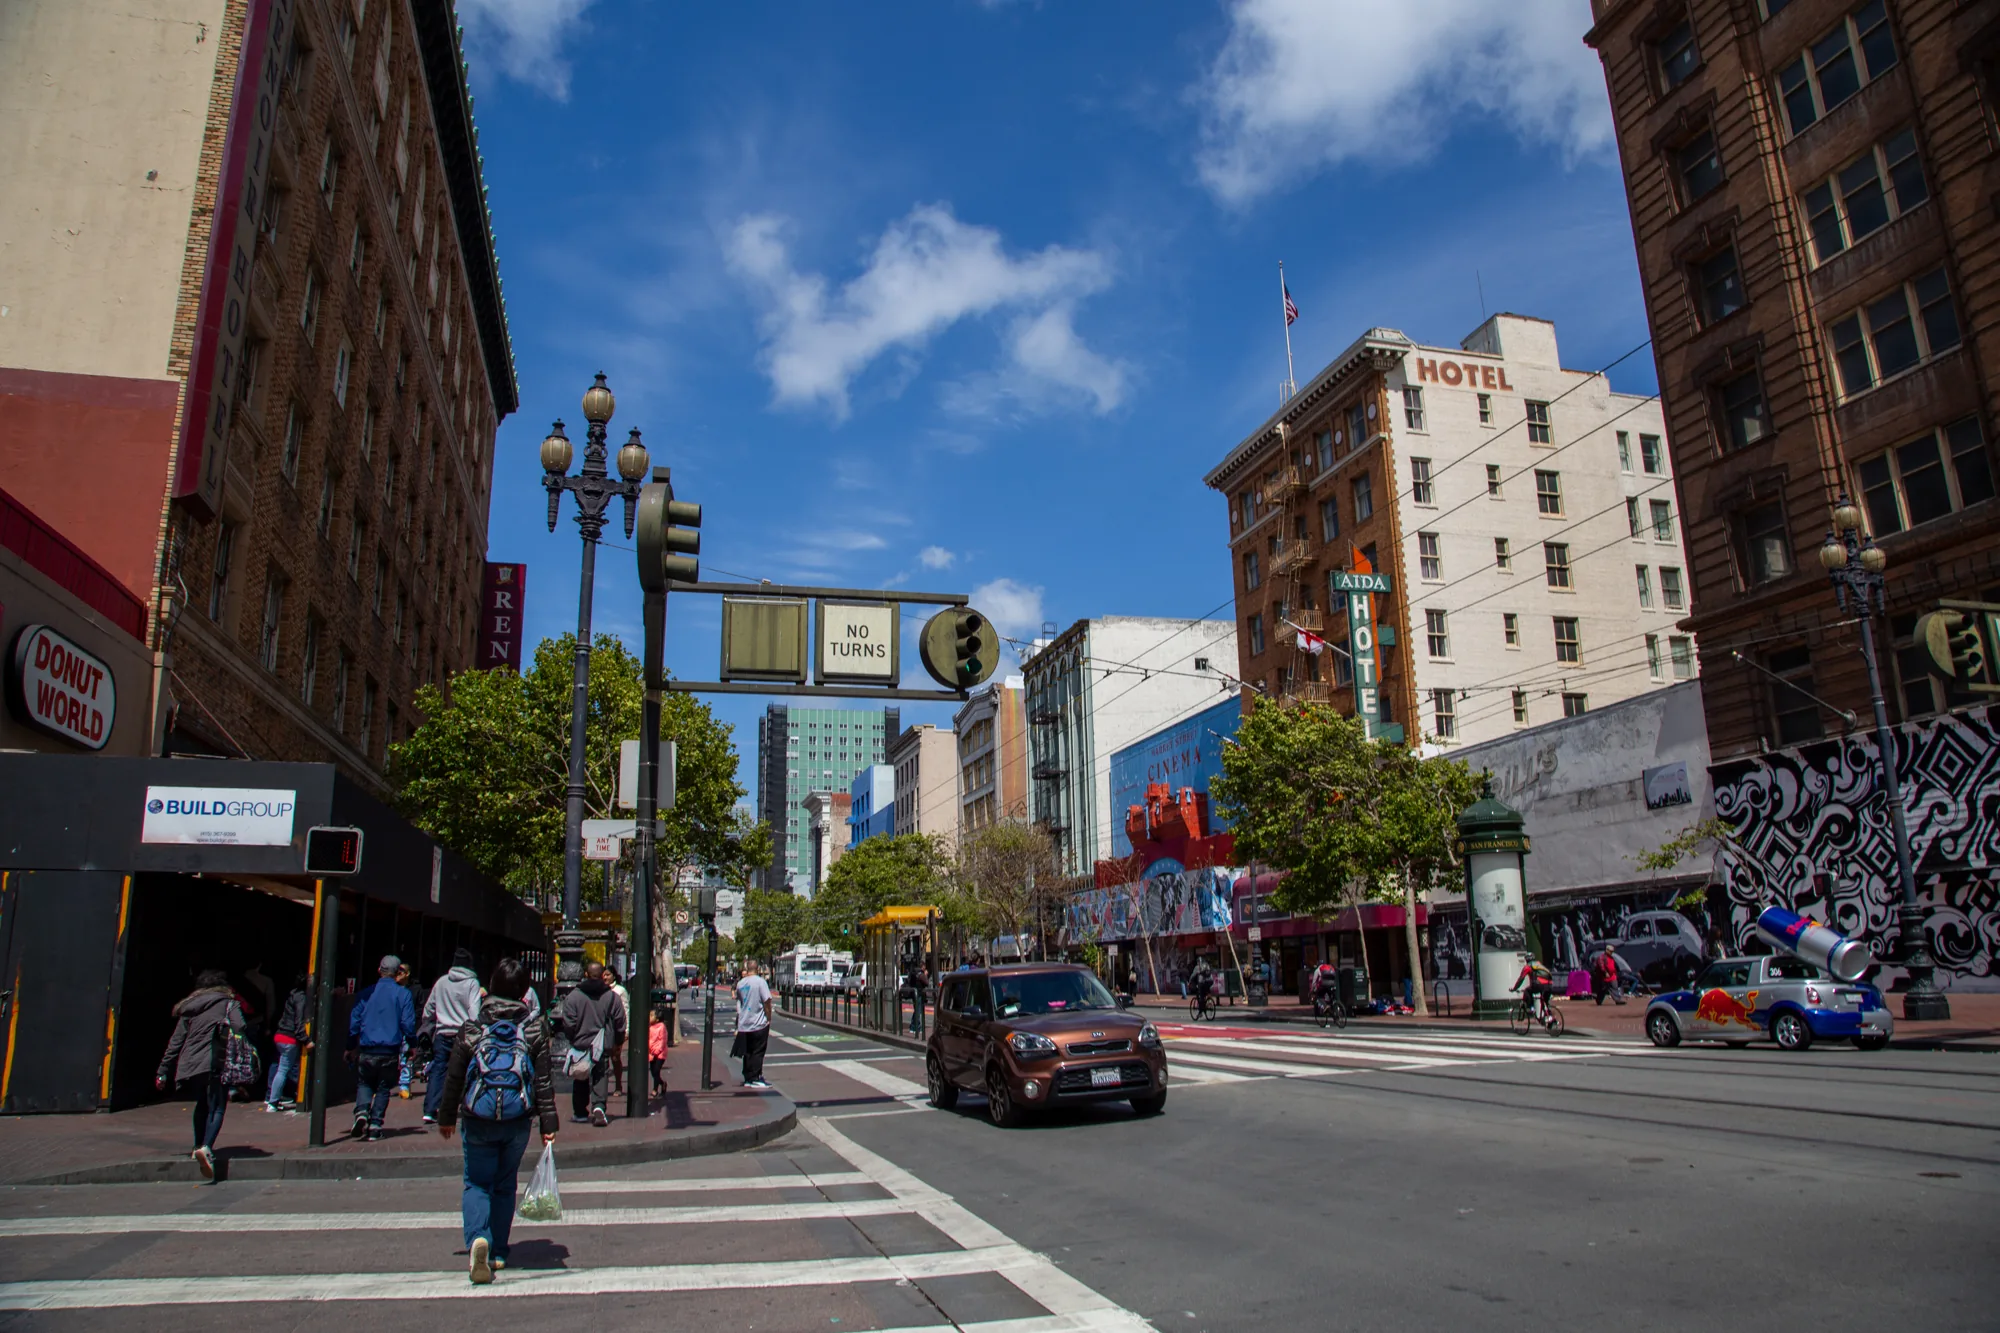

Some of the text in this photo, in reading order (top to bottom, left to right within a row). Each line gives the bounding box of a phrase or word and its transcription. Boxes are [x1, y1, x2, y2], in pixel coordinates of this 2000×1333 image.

[206, 0, 288, 490] ENOIR HOTEL
[1416, 357, 1514, 391] HOTEL
[1340, 575, 1386, 591] AIDA
[847, 624, 869, 639] NO
[35, 633, 104, 701] DONUT
[830, 642, 886, 658] TURNS
[1352, 594, 1378, 744] HOTEL
[37, 679, 104, 742] WORLD
[1148, 744, 1202, 782] CINEMA
[166, 800, 293, 817] BUILDGROUP
[1470, 840, 1519, 849] SAN FRANCISCO
